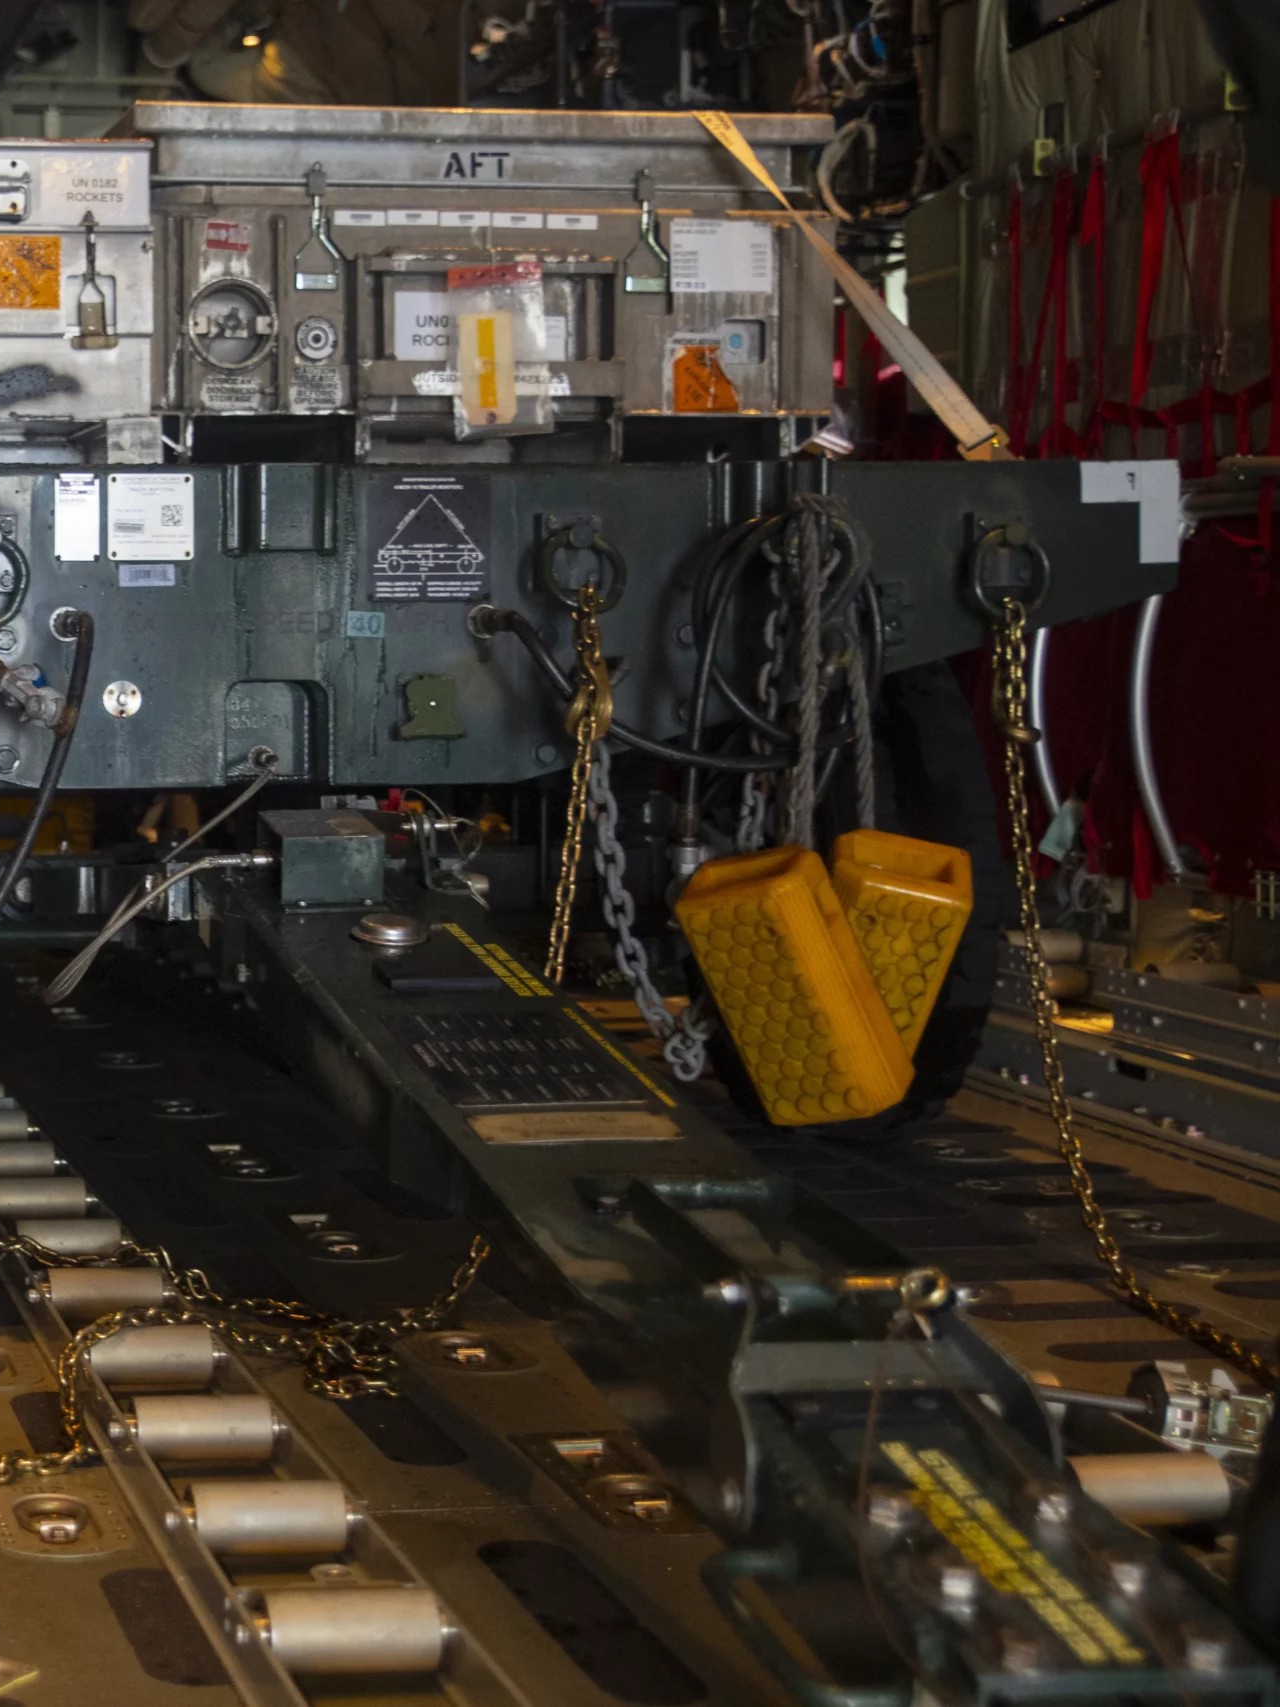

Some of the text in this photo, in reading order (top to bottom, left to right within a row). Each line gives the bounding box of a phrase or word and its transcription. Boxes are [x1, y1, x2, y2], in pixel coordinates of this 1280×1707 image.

[443, 152, 510, 178] AFT
[72, 179, 118, 188] UN 0182
[66, 192, 124, 203] ROCKETS
[350, 614, 382, 635] 40
